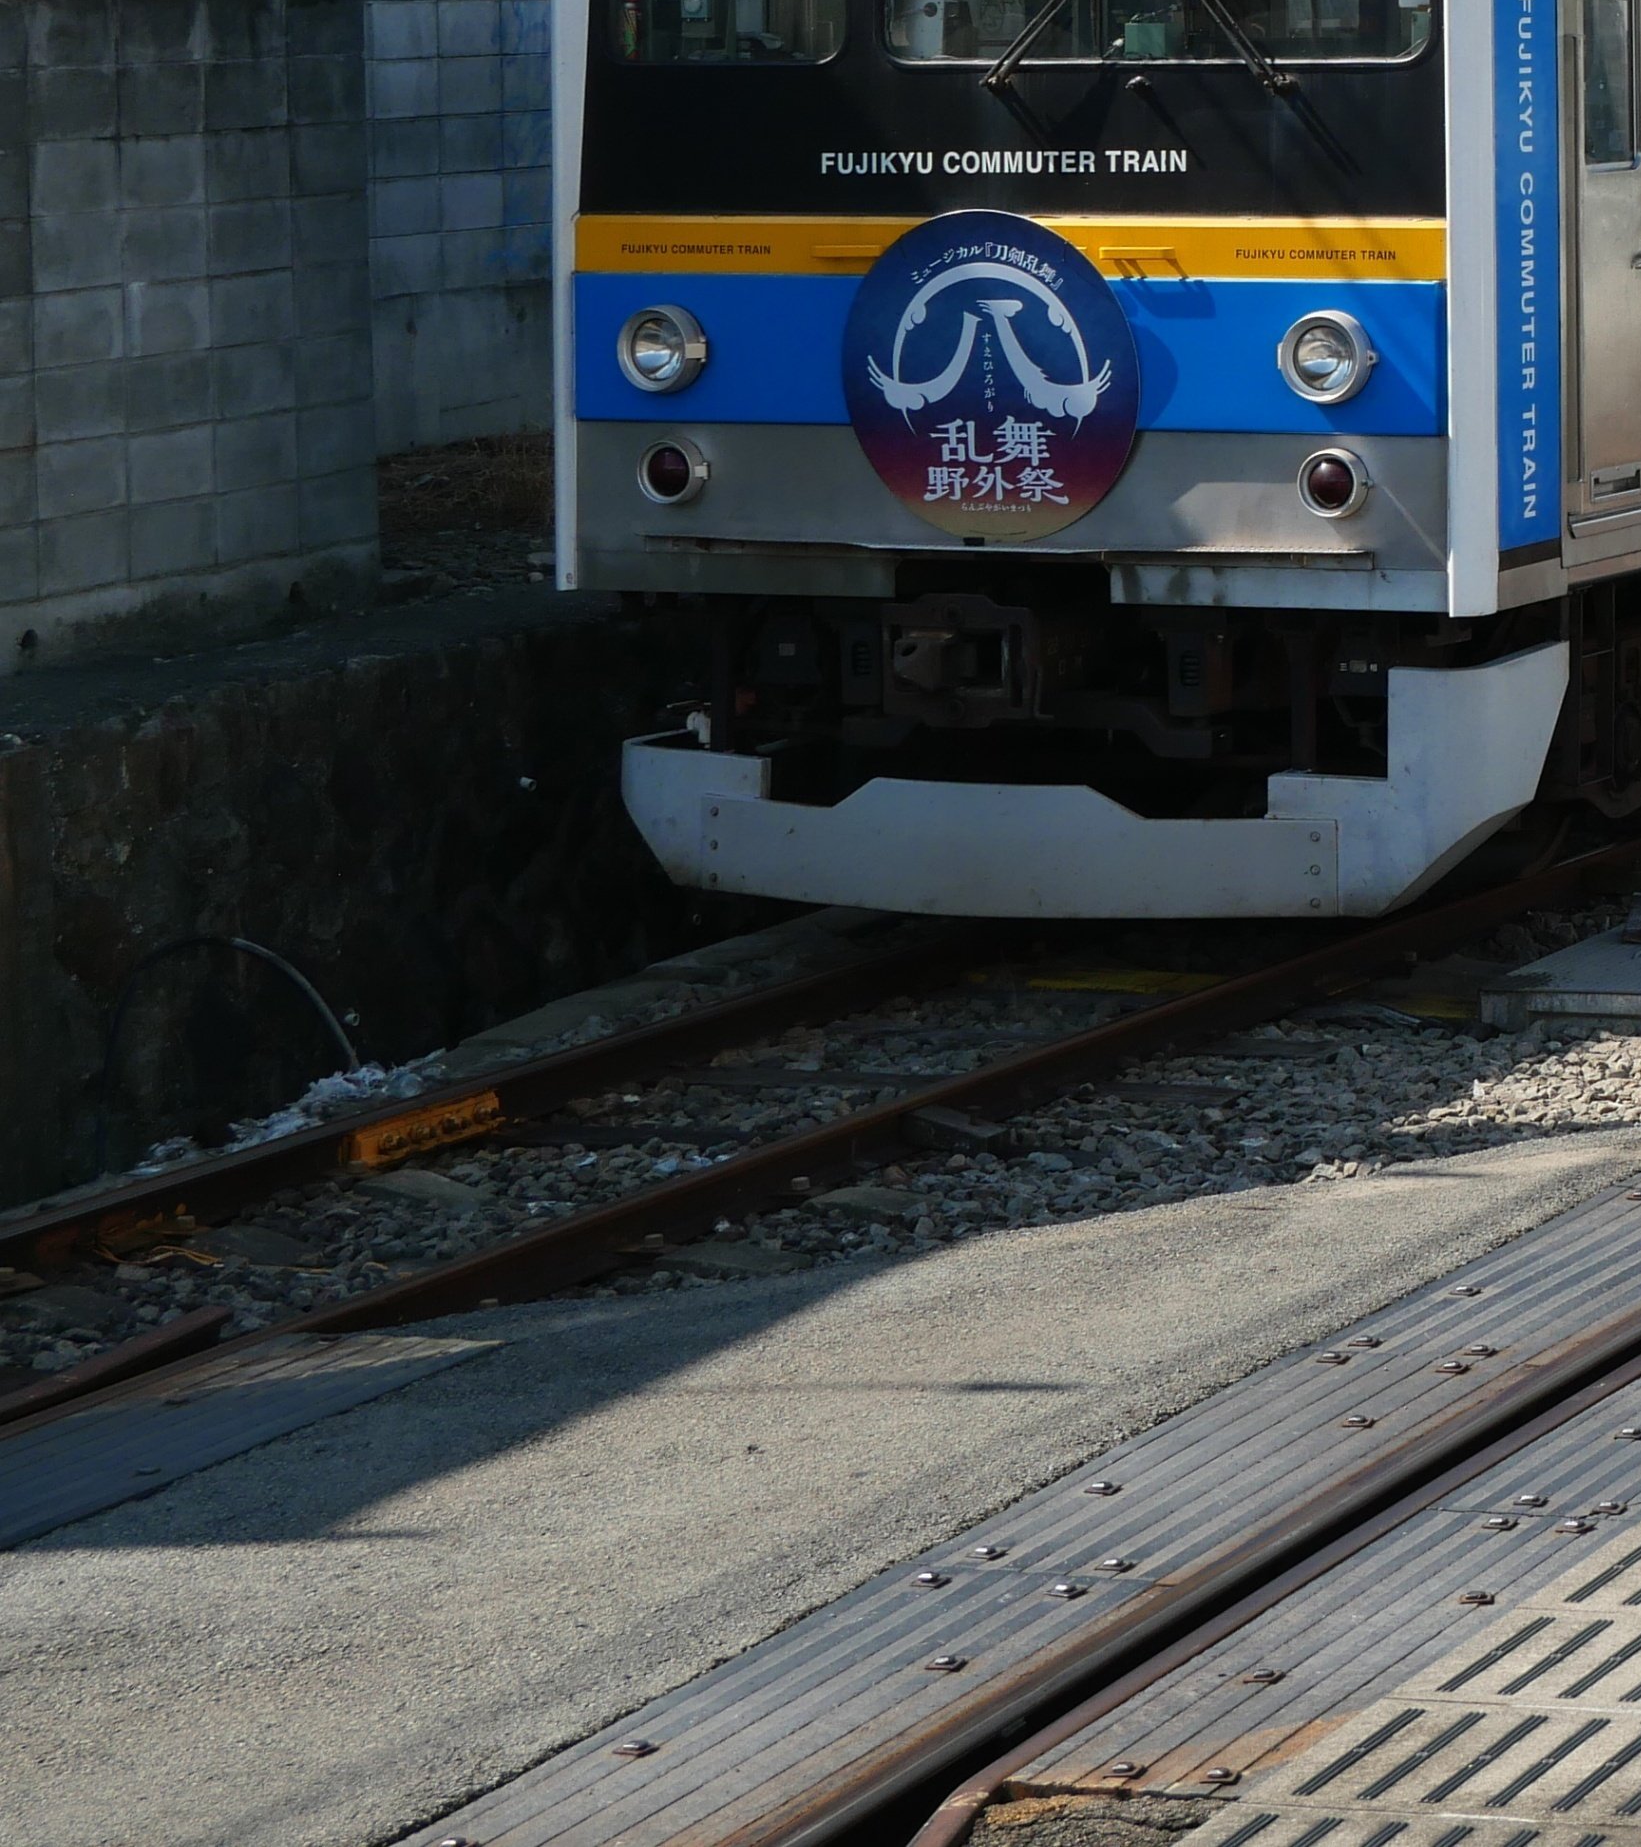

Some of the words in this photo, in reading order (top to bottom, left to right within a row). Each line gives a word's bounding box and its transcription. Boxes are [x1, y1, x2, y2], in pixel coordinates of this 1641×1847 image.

[821, 150, 934, 176] FUJIKYU
[942, 149, 1096, 175] COMMUTER
[1106, 148, 1188, 174] TRAIN
[621, 242, 668, 257] FUJIKYU
[669, 243, 731, 257] COMMUTER
[732, 244, 772, 257] TRAIN
[1235, 248, 1287, 261] FUJIKYU
[1289, 248, 1353, 262] COMMUTER
[1355, 249, 1397, 262] TRAIN
[1519, 172, 1536, 391] COMMUTER
[981, 331, 996, 413] すえひろがり
[929, 415, 1057, 466] 乱舞
[1521, 405, 1537, 520] TRAIN
[923, 466, 1070, 505] 野外祭
